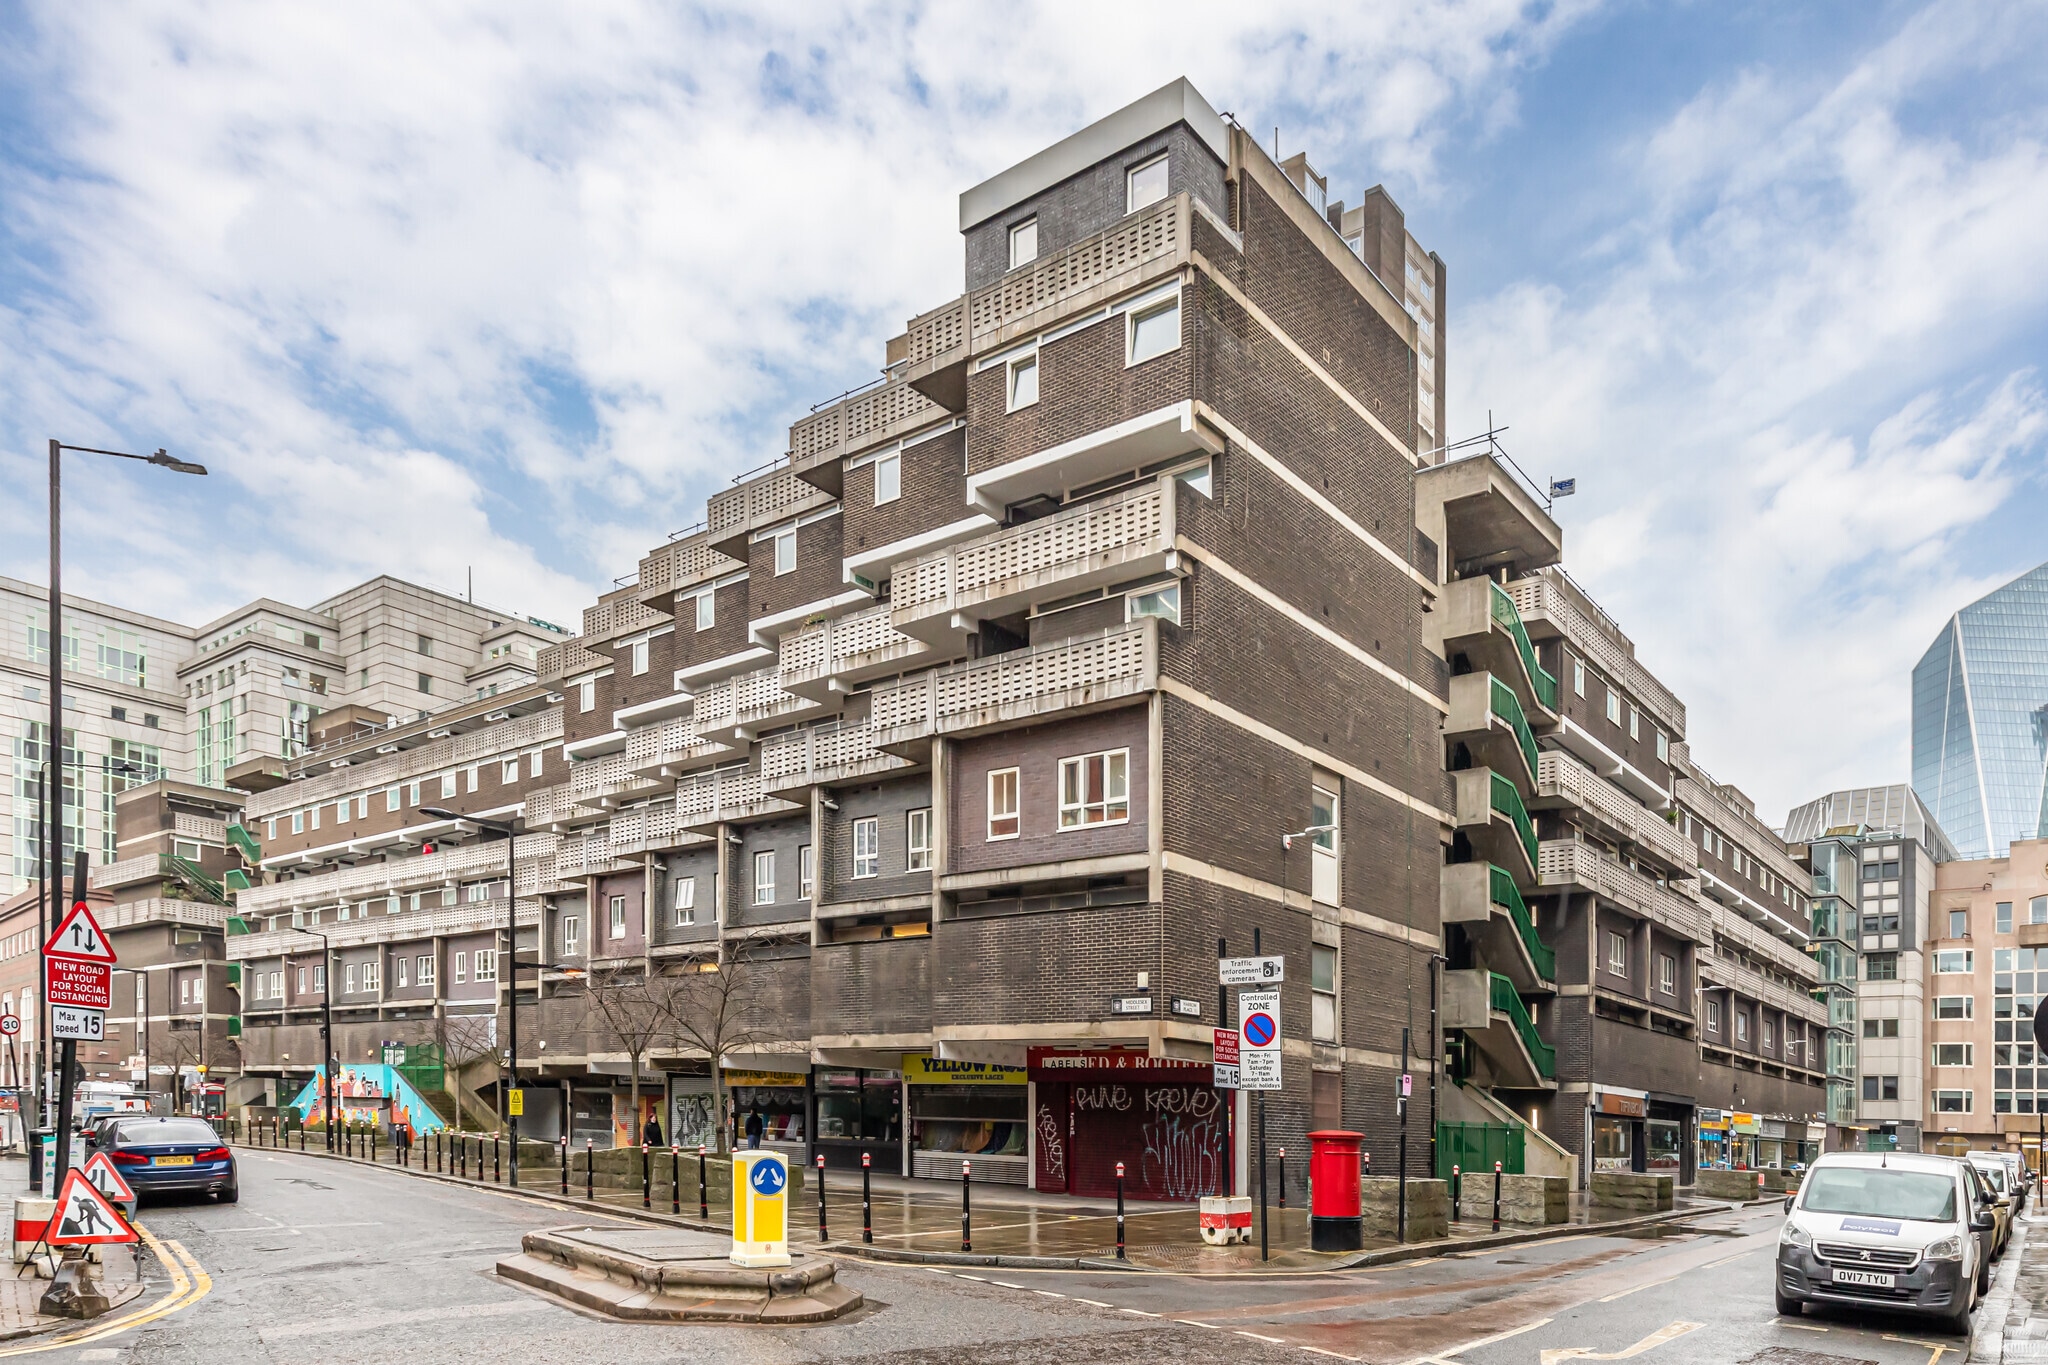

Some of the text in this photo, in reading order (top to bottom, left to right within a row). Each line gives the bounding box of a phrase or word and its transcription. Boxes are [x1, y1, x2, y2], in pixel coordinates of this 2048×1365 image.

[55, 962, 104, 975] NEW ROAD
[1221, 967, 1262, 975] enforcement
[63, 973, 97, 983] LAYOUT
[53, 981, 106, 994] FOR SOCIAL
[51, 991, 108, 1004] DISTANCING
[1248, 1002, 1270, 1010] ZONE
[3, 1020, 19, 1030] 30
[55, 1025, 79, 1033] speed
[59, 1011, 100, 1034] Max 15
[921, 1058, 986, 1072] YELLOW
[1043, 1058, 1086, 1068] LABELS
[1230, 1070, 1239, 1084] 15
[1840, 1271, 1887, 1285] OV17 TYU
